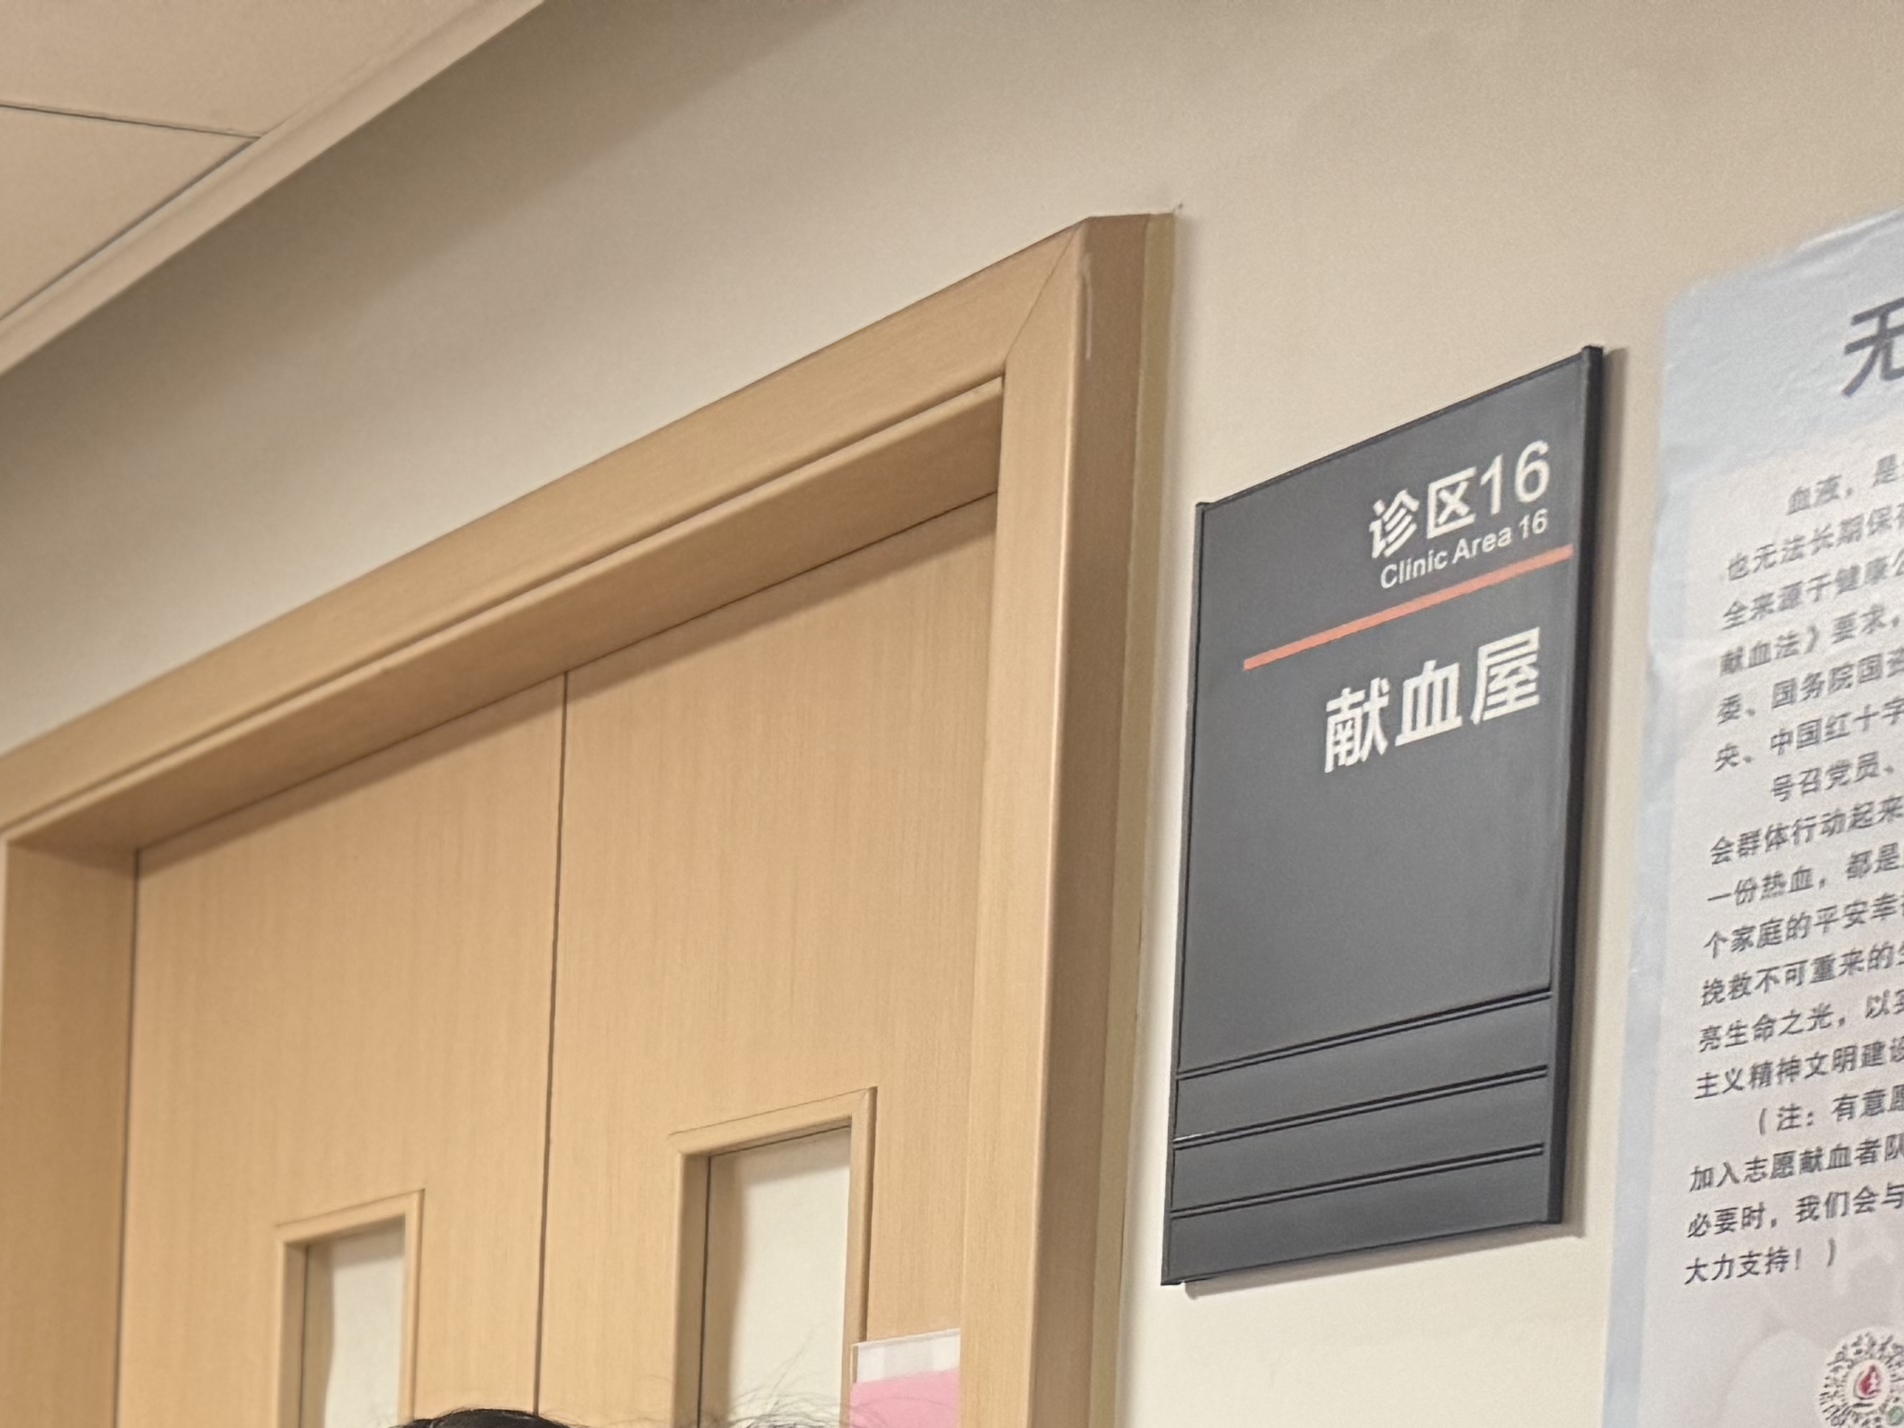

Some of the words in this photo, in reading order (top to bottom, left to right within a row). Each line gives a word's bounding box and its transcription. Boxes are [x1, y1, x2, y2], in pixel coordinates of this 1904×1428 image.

[1841, 297, 1904, 397] 无
[1369, 440, 1550, 559] 诊区16
[1380, 549, 1448, 589] Clinic
[1452, 527, 1513, 565] Area
[1519, 508, 1549, 539] 16
[1325, 626, 1540, 773] 献血屋
[1704, 892, 1904, 959] 个家庭的平安幸
